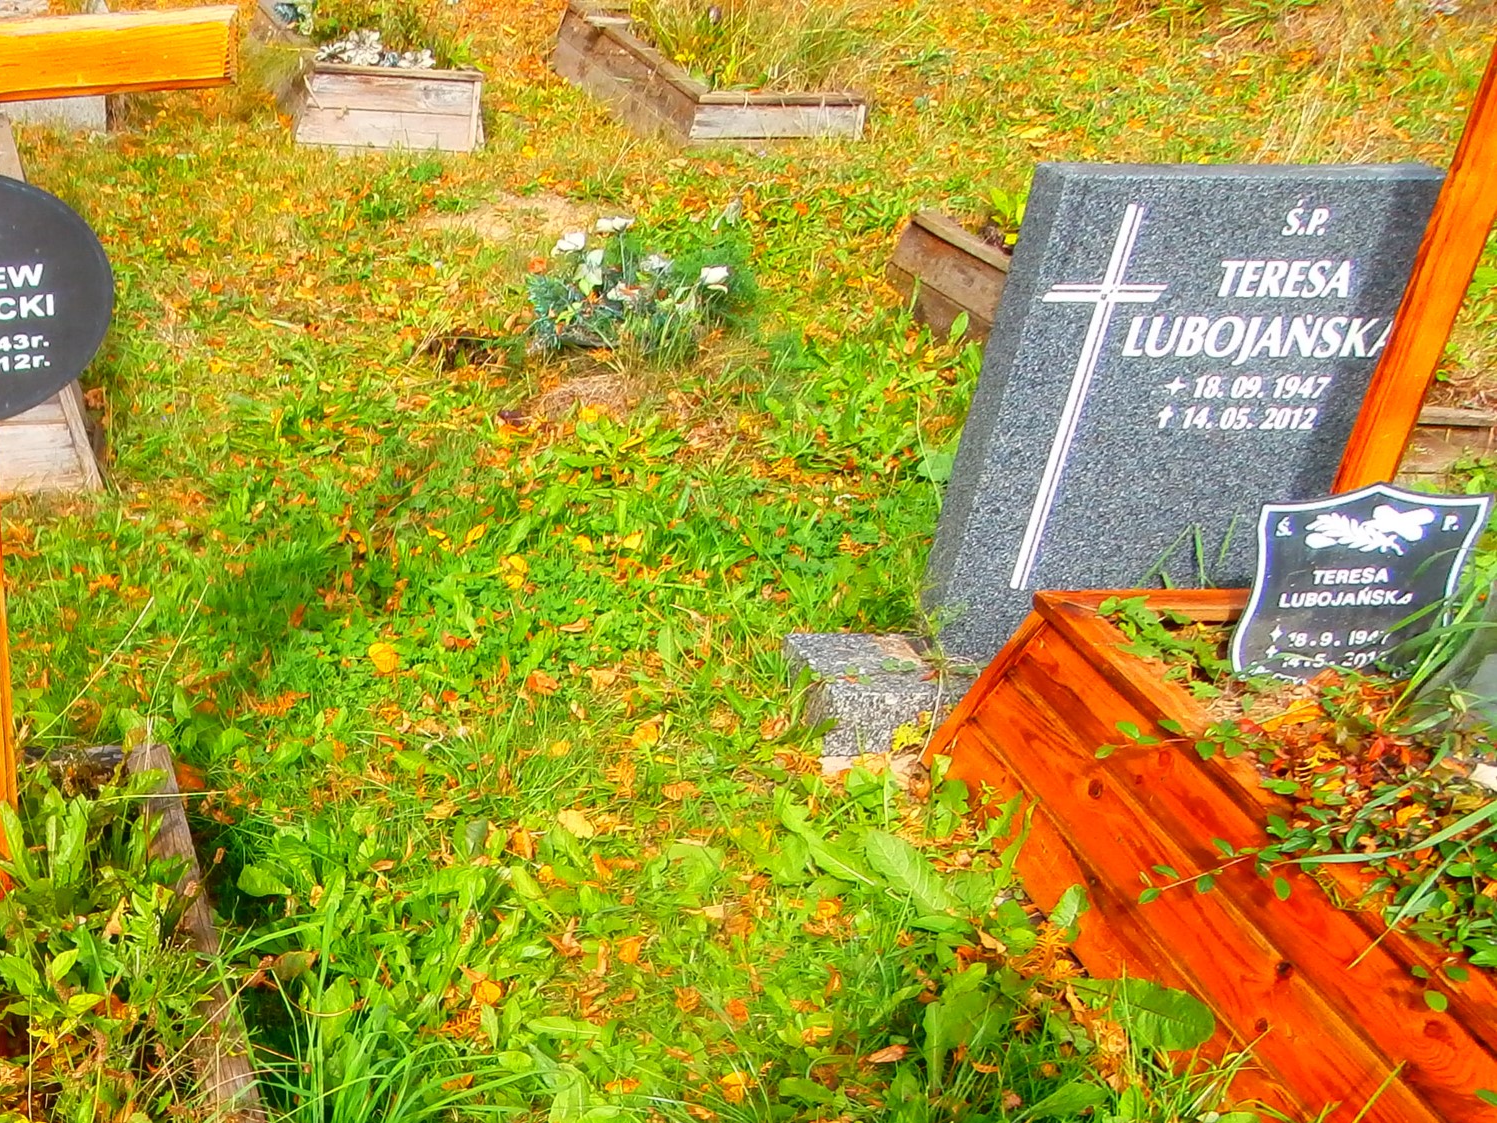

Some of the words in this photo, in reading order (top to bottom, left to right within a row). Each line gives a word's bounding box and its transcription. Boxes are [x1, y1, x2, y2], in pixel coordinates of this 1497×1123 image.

[1282, 200, 1329, 236] Ś.P.
[1216, 259, 1353, 299] TERESA
[1272, 375, 1333, 399] 1947
[1258, 406, 1319, 430] 2012
[1312, 567, 1389, 585] TERESA
